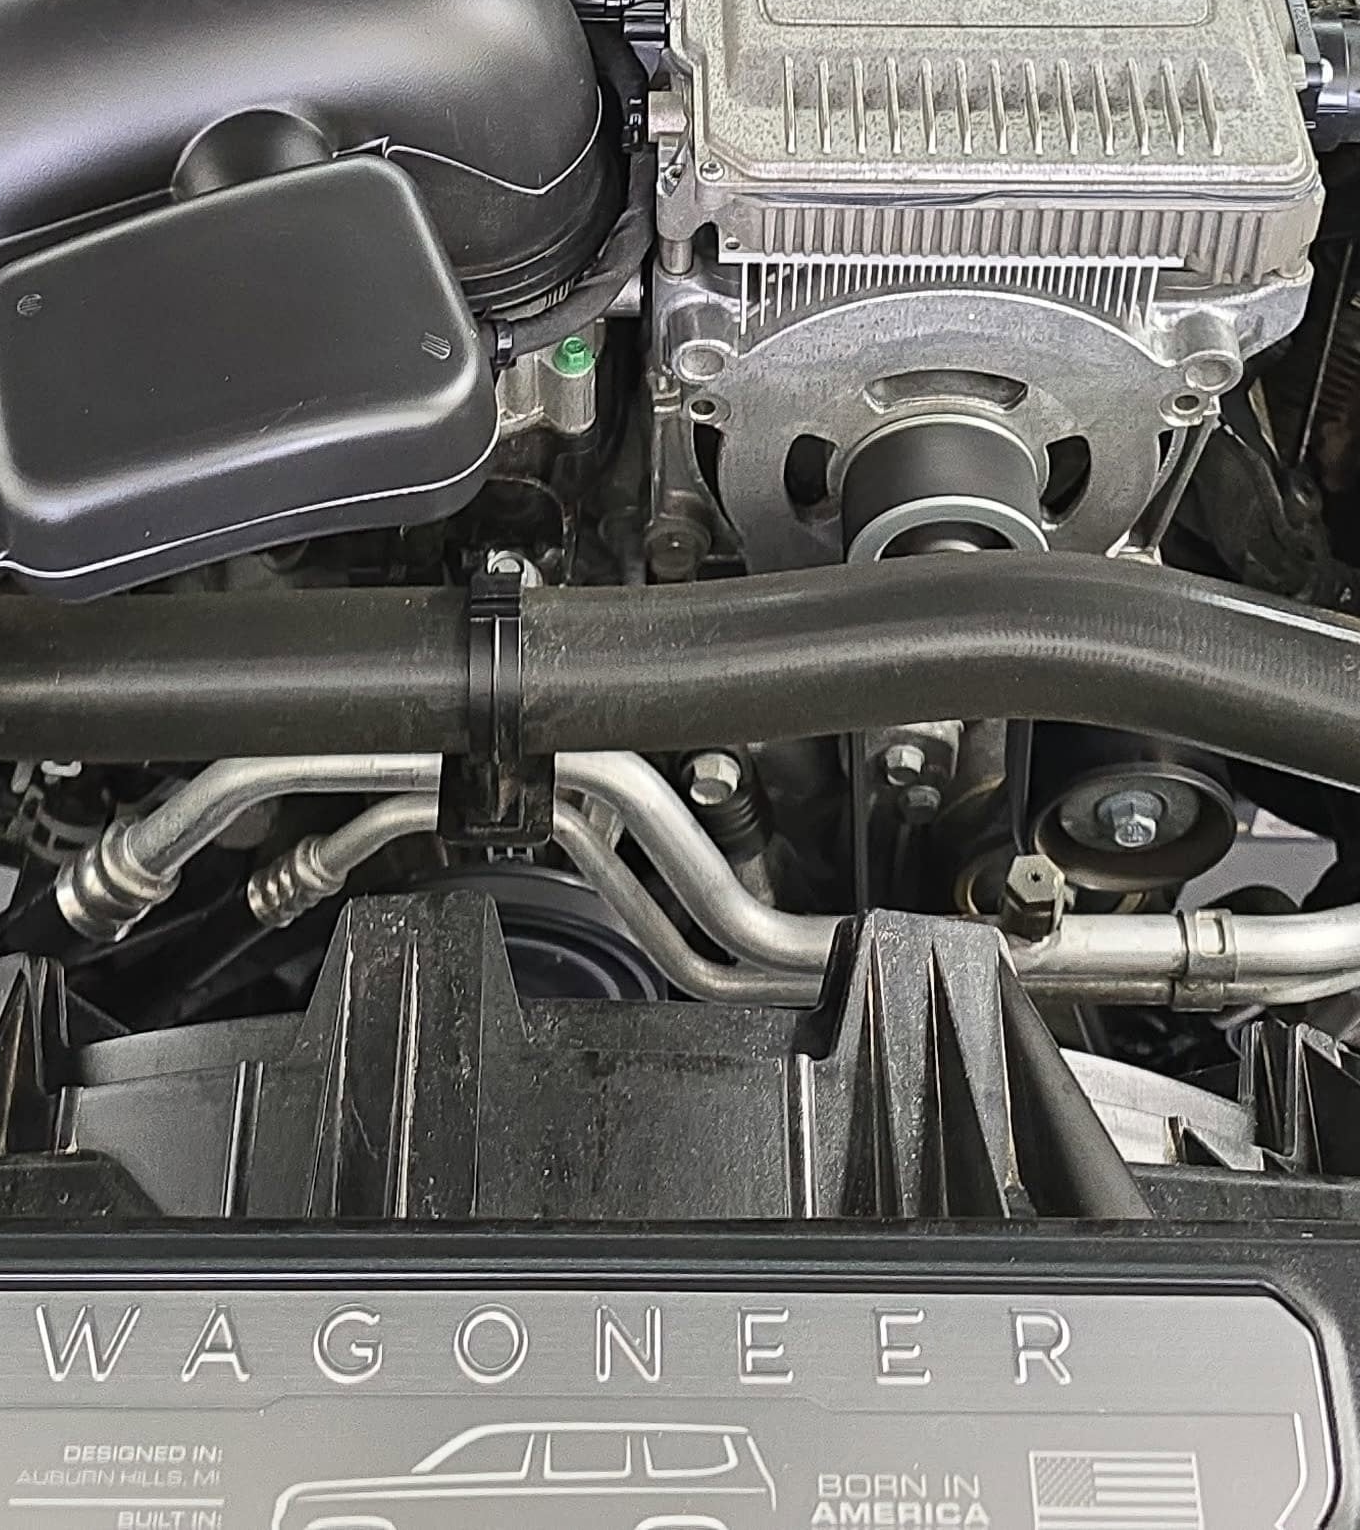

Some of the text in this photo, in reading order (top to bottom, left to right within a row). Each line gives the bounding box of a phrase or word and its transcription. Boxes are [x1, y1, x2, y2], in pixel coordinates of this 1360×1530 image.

[34, 1303, 1074, 1386] WAGONEER
[63, 1444, 186, 1463] DESIGNED
[15, 1470, 115, 1488] AUBURN
[193, 1470, 220, 1487] MI
[818, 1473, 981, 1499] BORN IN
[117, 1511, 185, 1528] BUILT
[811, 1501, 991, 1526] AMERICA
